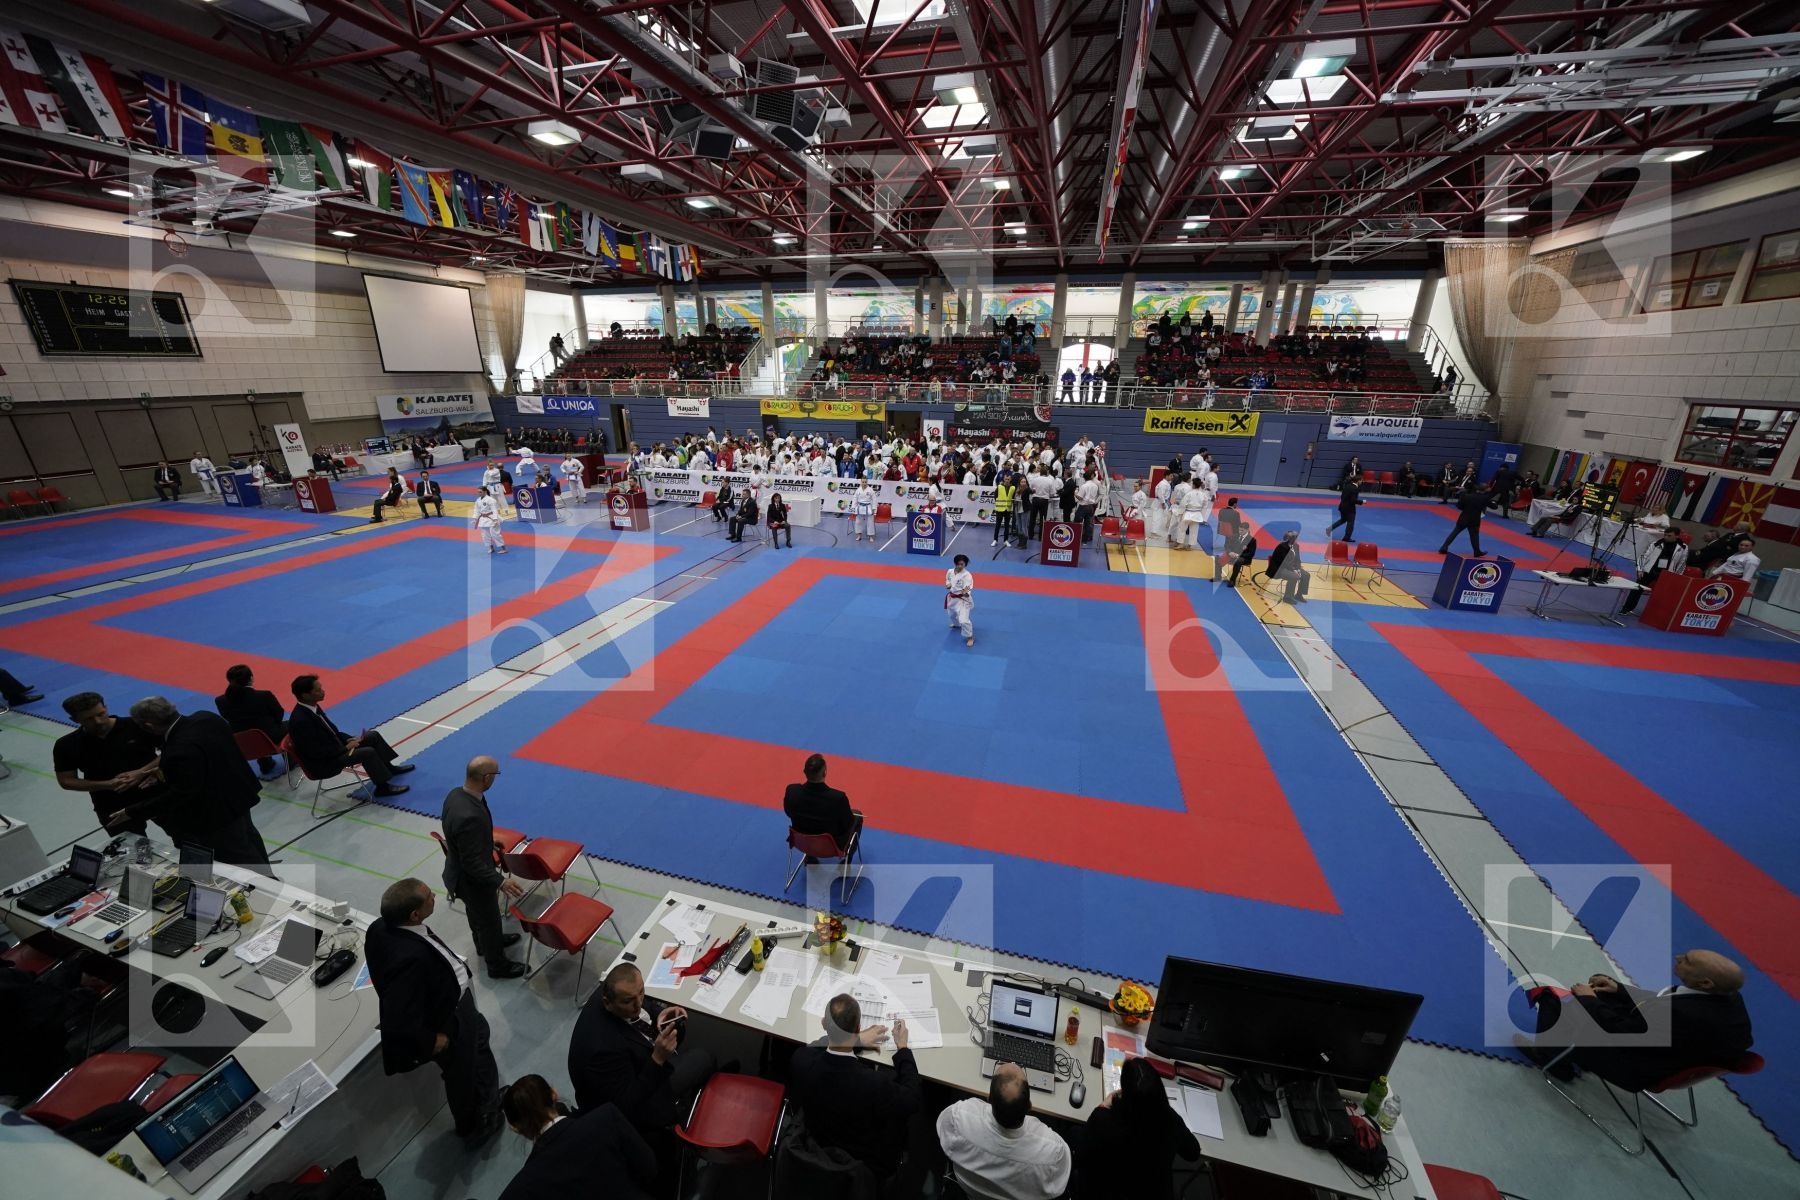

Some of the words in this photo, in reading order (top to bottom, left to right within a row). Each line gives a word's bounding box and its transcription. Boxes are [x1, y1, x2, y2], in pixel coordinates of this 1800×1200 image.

[88, 294, 127, 305] 12:26
[931, 302, 936, 310] E
[561, 400, 595, 411] UNIQA
[832, 402, 853, 412] RAUCH
[1150, 416, 1224, 431] Raiffeisen
[1361, 418, 1420, 428] ALPQUELL
[957, 428, 990, 438] Hayashi
[1012, 429, 1046, 439] Haashi
[1359, 431, 1417, 439] www.alpquell.com
[773, 485, 814, 494] SALZBURG
[913, 542, 934, 550] TOKYO
[1050, 552, 1071, 560] TOKYO
[1462, 595, 1491, 604] TOKYO
[1684, 617, 1717, 628] TOKYO
